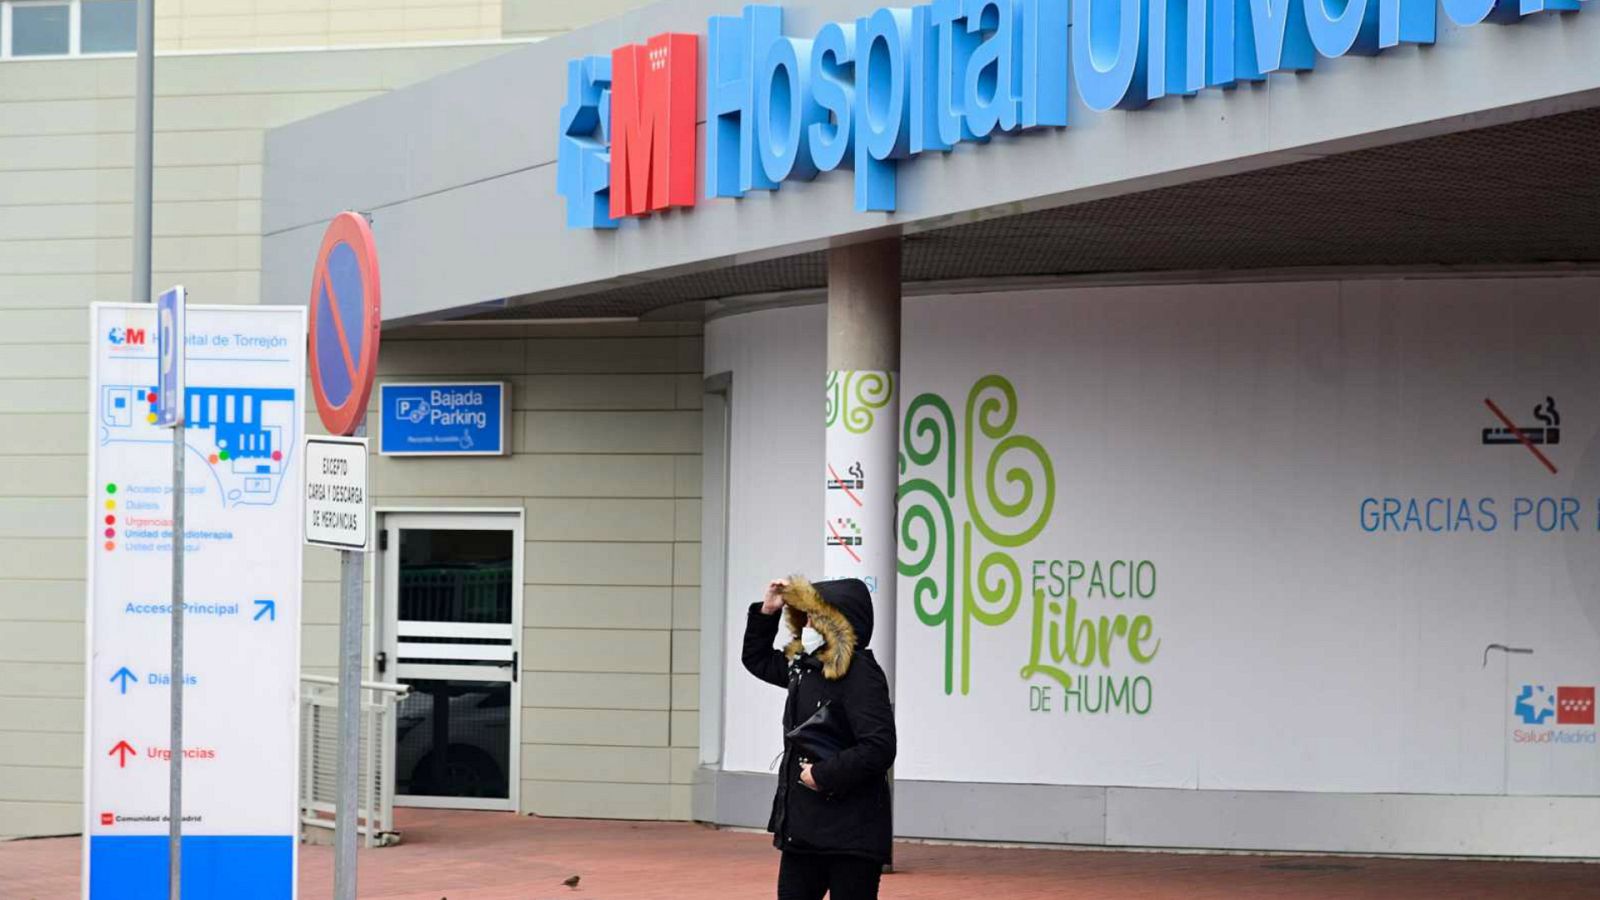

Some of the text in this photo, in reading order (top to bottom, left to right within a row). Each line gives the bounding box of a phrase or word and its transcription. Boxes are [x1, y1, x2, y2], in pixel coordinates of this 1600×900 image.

[706, 0, 1066, 212] Hospital
[213, 335, 229, 346] de
[233, 334, 287, 348] Torrejón
[431, 390, 483, 409] Bajada
[430, 409, 487, 428] Parking
[323, 458, 347, 475] EXCEPTO
[308, 483, 325, 500] CARGA
[332, 485, 362, 504] DESCARGA
[313, 510, 320, 527] DE
[1360, 497, 1498, 533] GRACIAS
[1513, 497, 1581, 533] POR
[126, 530, 158, 538] Unidad
[1032, 559, 1157, 599] ESPACIO
[1019, 588, 1162, 689] Libre
[1029, 674, 1153, 715] DE HUMO
[147, 748, 215, 760] Urgncias
[181, 814, 202, 822] adrid
